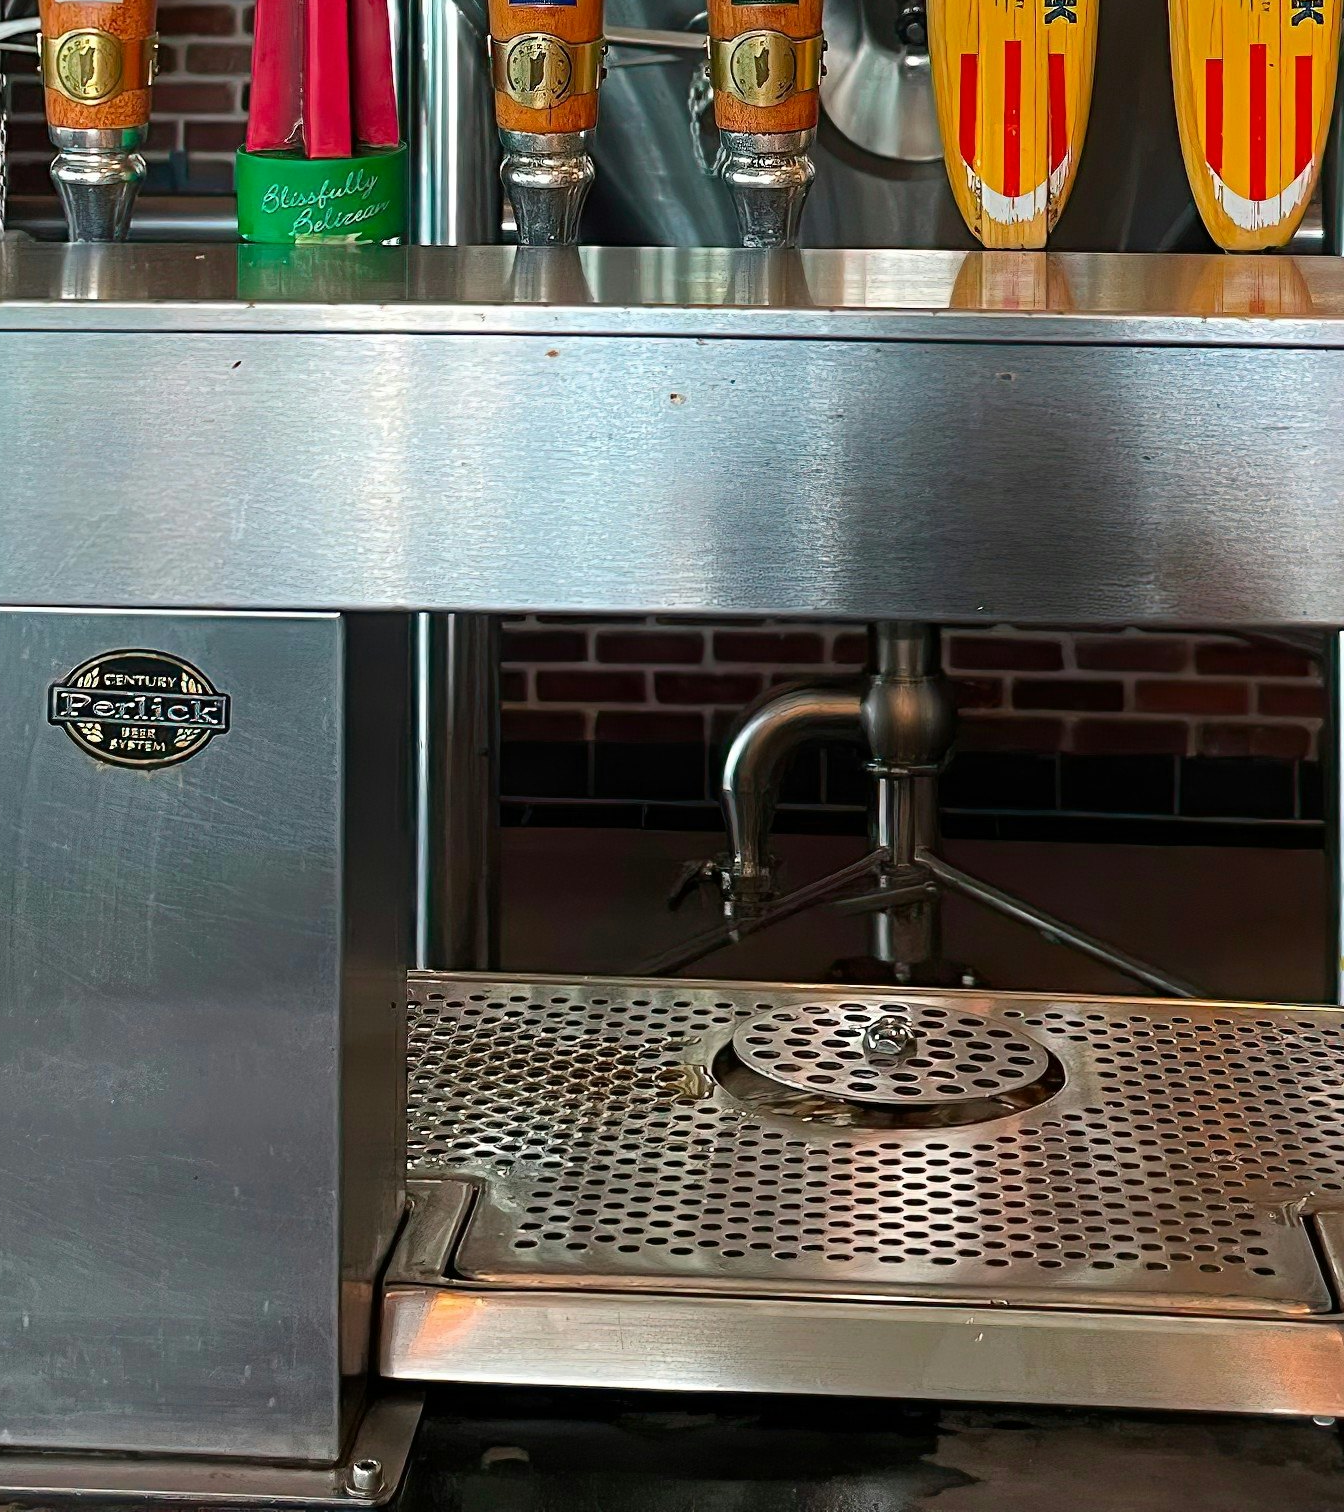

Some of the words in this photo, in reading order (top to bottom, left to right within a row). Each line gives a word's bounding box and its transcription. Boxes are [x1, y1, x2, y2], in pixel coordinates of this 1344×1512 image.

[261, 169, 378, 214] Blissfully
[288, 199, 391, 236] Belizean
[103, 673, 178, 688] CENTURY
[59, 692, 219, 724] Perlick
[121, 727, 156, 739] BEER
[108, 739, 167, 752] SYSTEM
